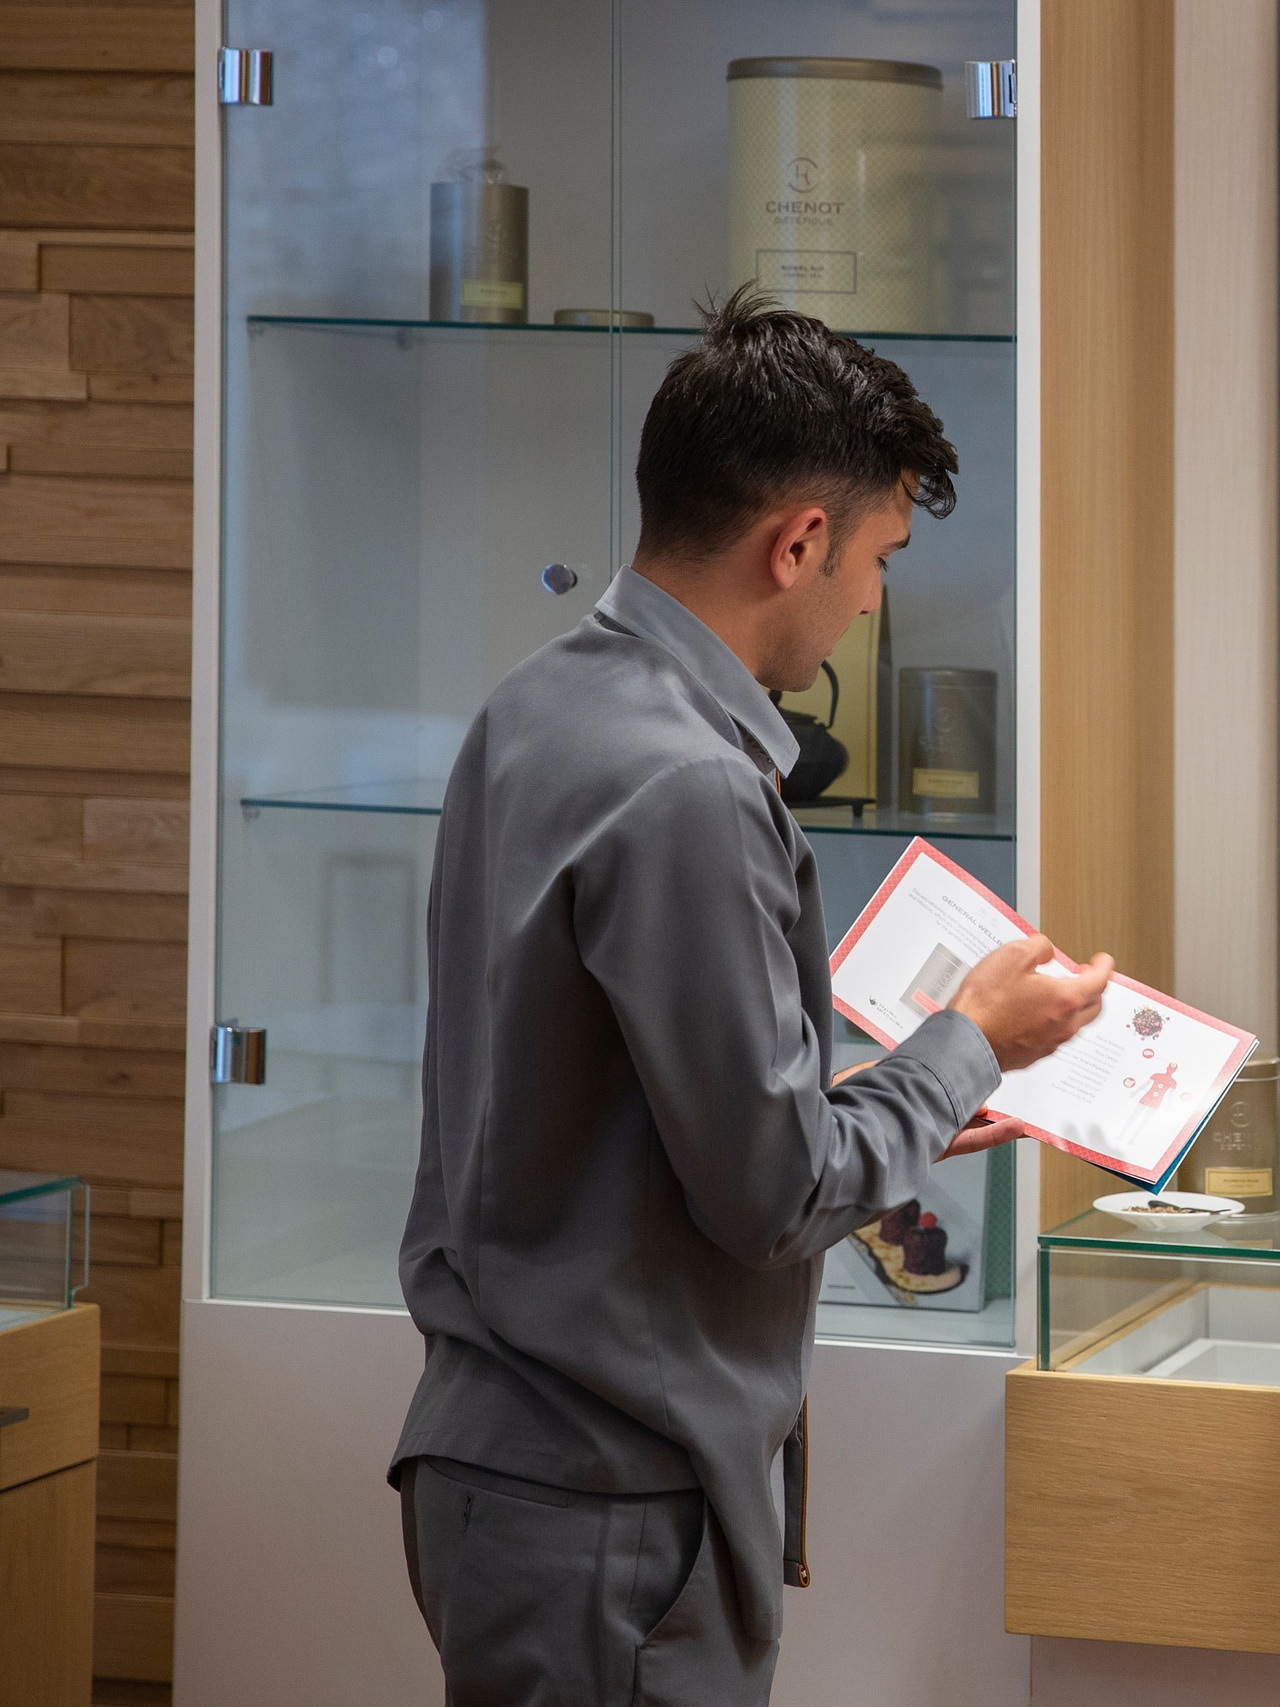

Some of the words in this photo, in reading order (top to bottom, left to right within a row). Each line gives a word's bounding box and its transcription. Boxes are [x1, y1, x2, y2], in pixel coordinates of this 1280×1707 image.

[766, 201, 844, 214] CHENOT
[941, 895, 978, 926] GENERAL
[978, 923, 1003, 947] WELLB
